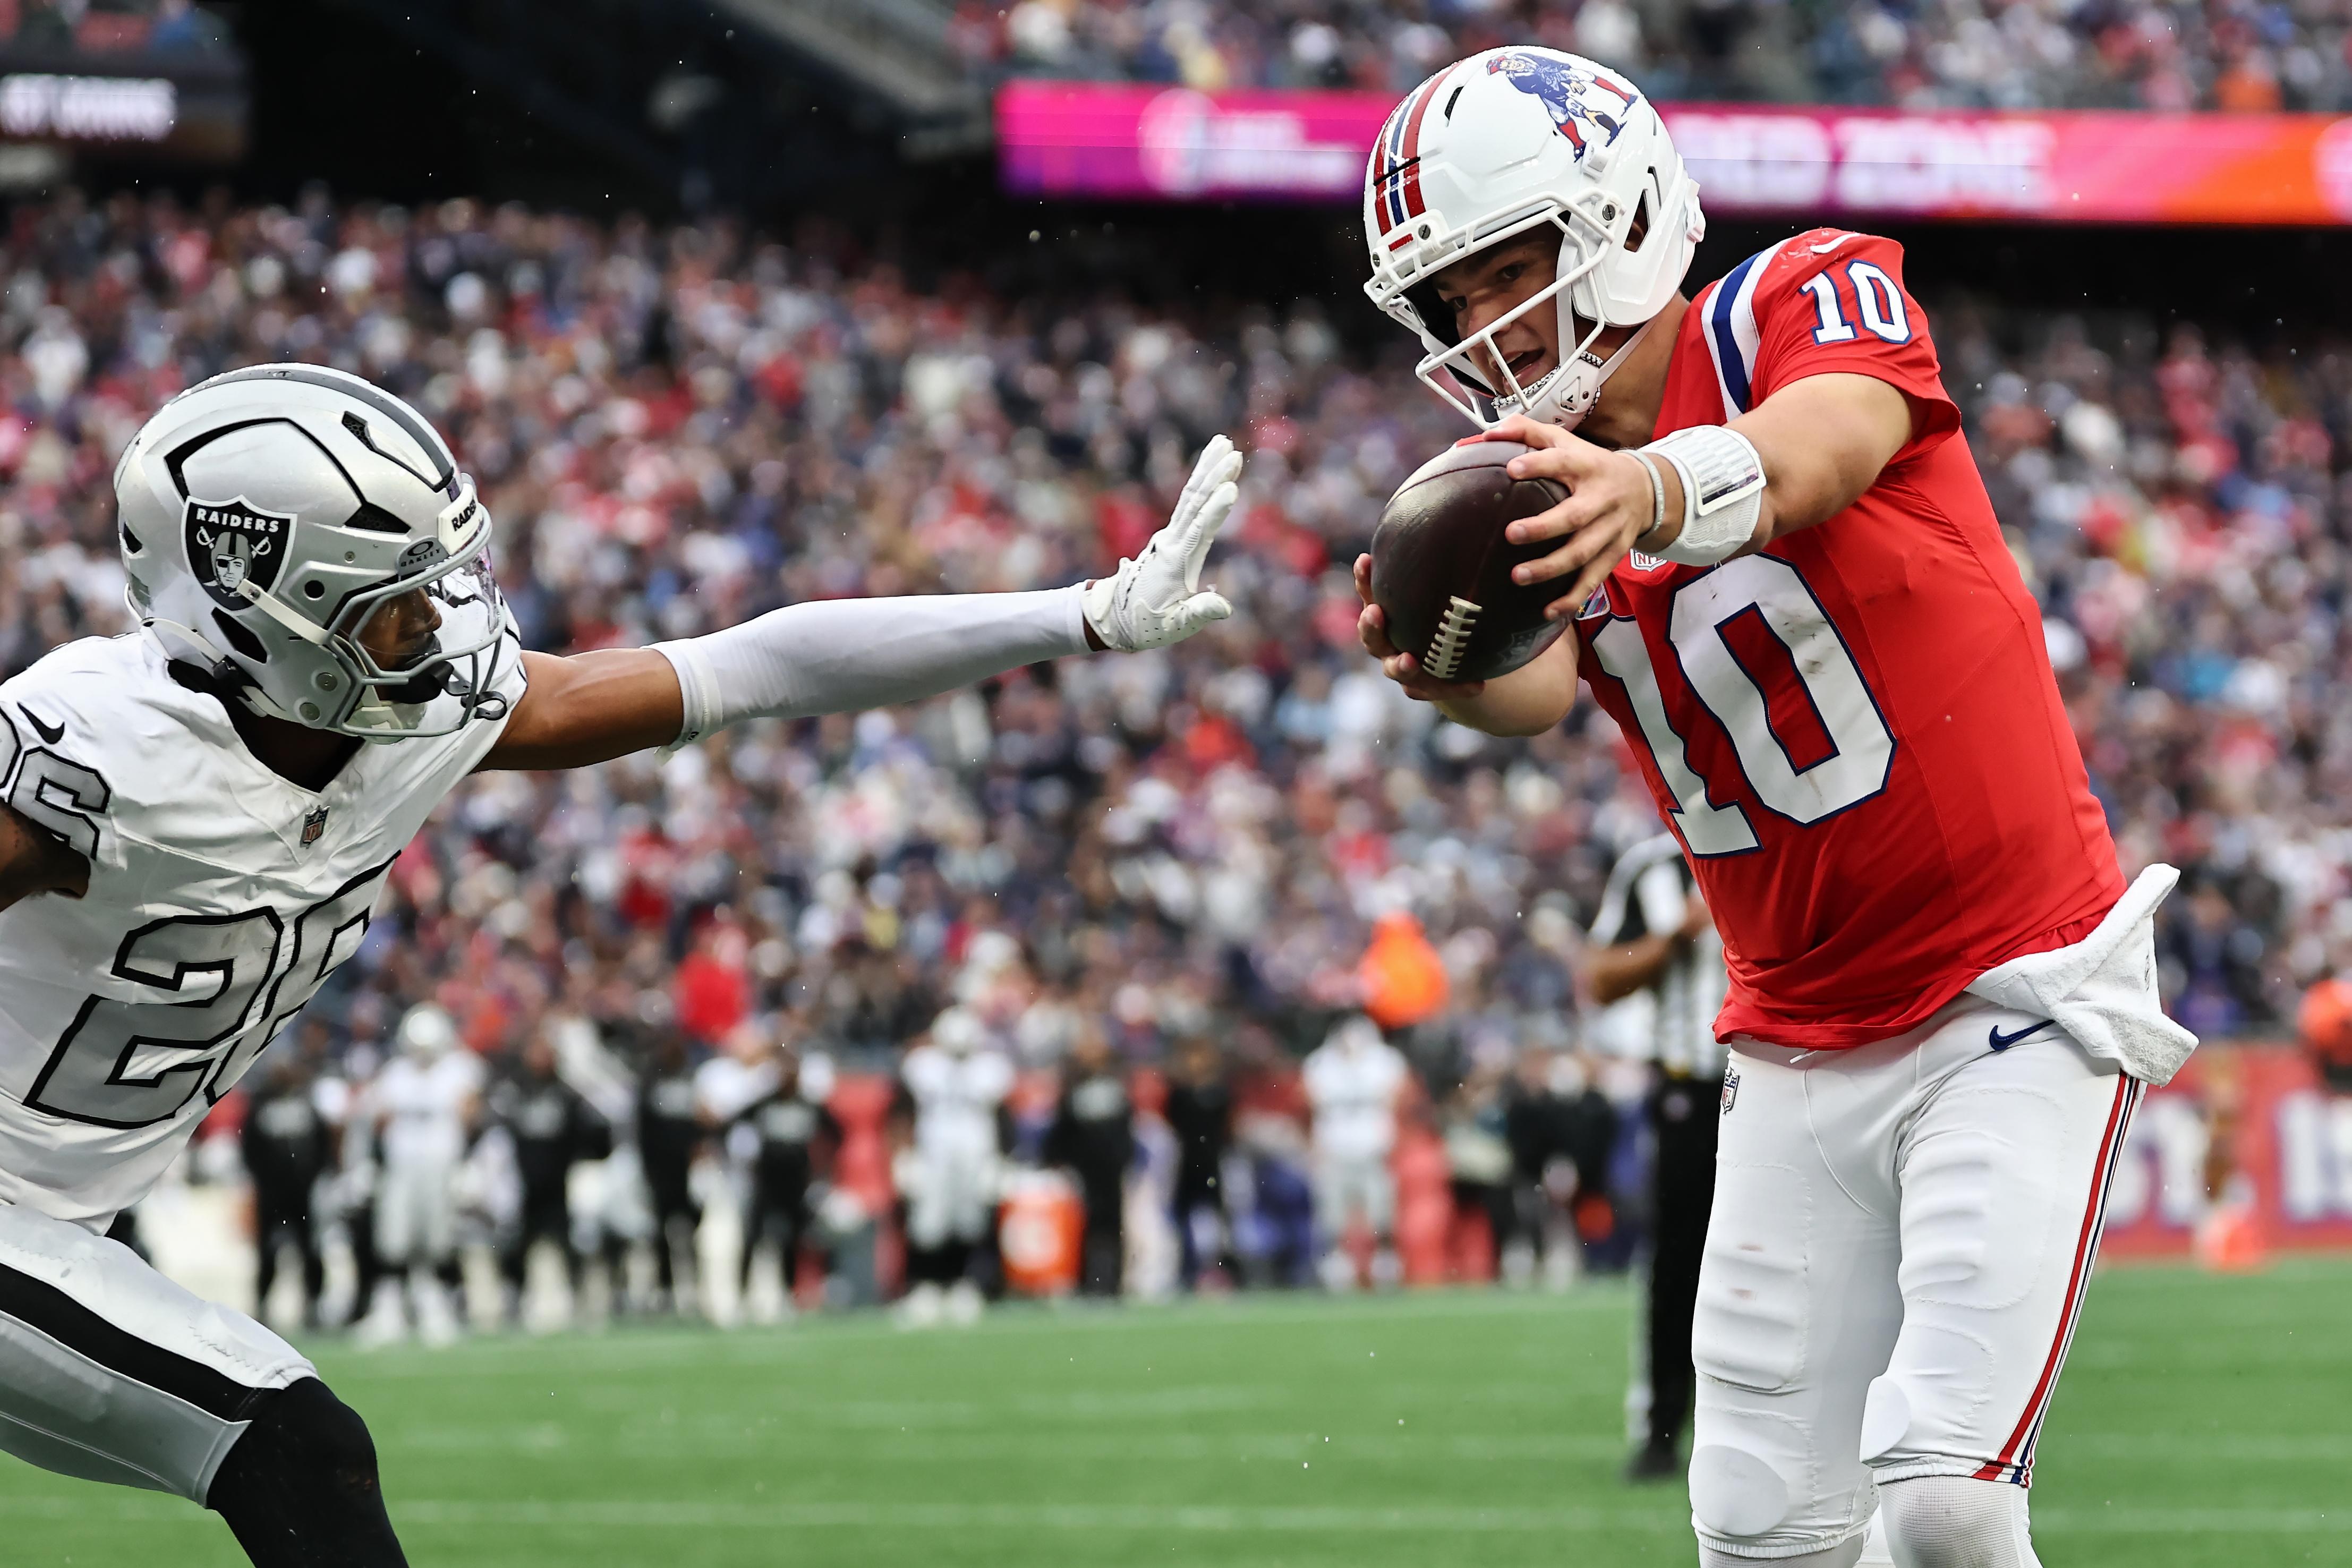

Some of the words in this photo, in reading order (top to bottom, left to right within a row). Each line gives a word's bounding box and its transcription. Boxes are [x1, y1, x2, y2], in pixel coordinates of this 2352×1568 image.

[1799, 259, 1912, 345] 10
[196, 507, 279, 533] RAIDERS
[451, 498, 476, 532] RAID
[400, 549, 440, 567] OAKLEY
[1591, 551, 1898, 859] 10
